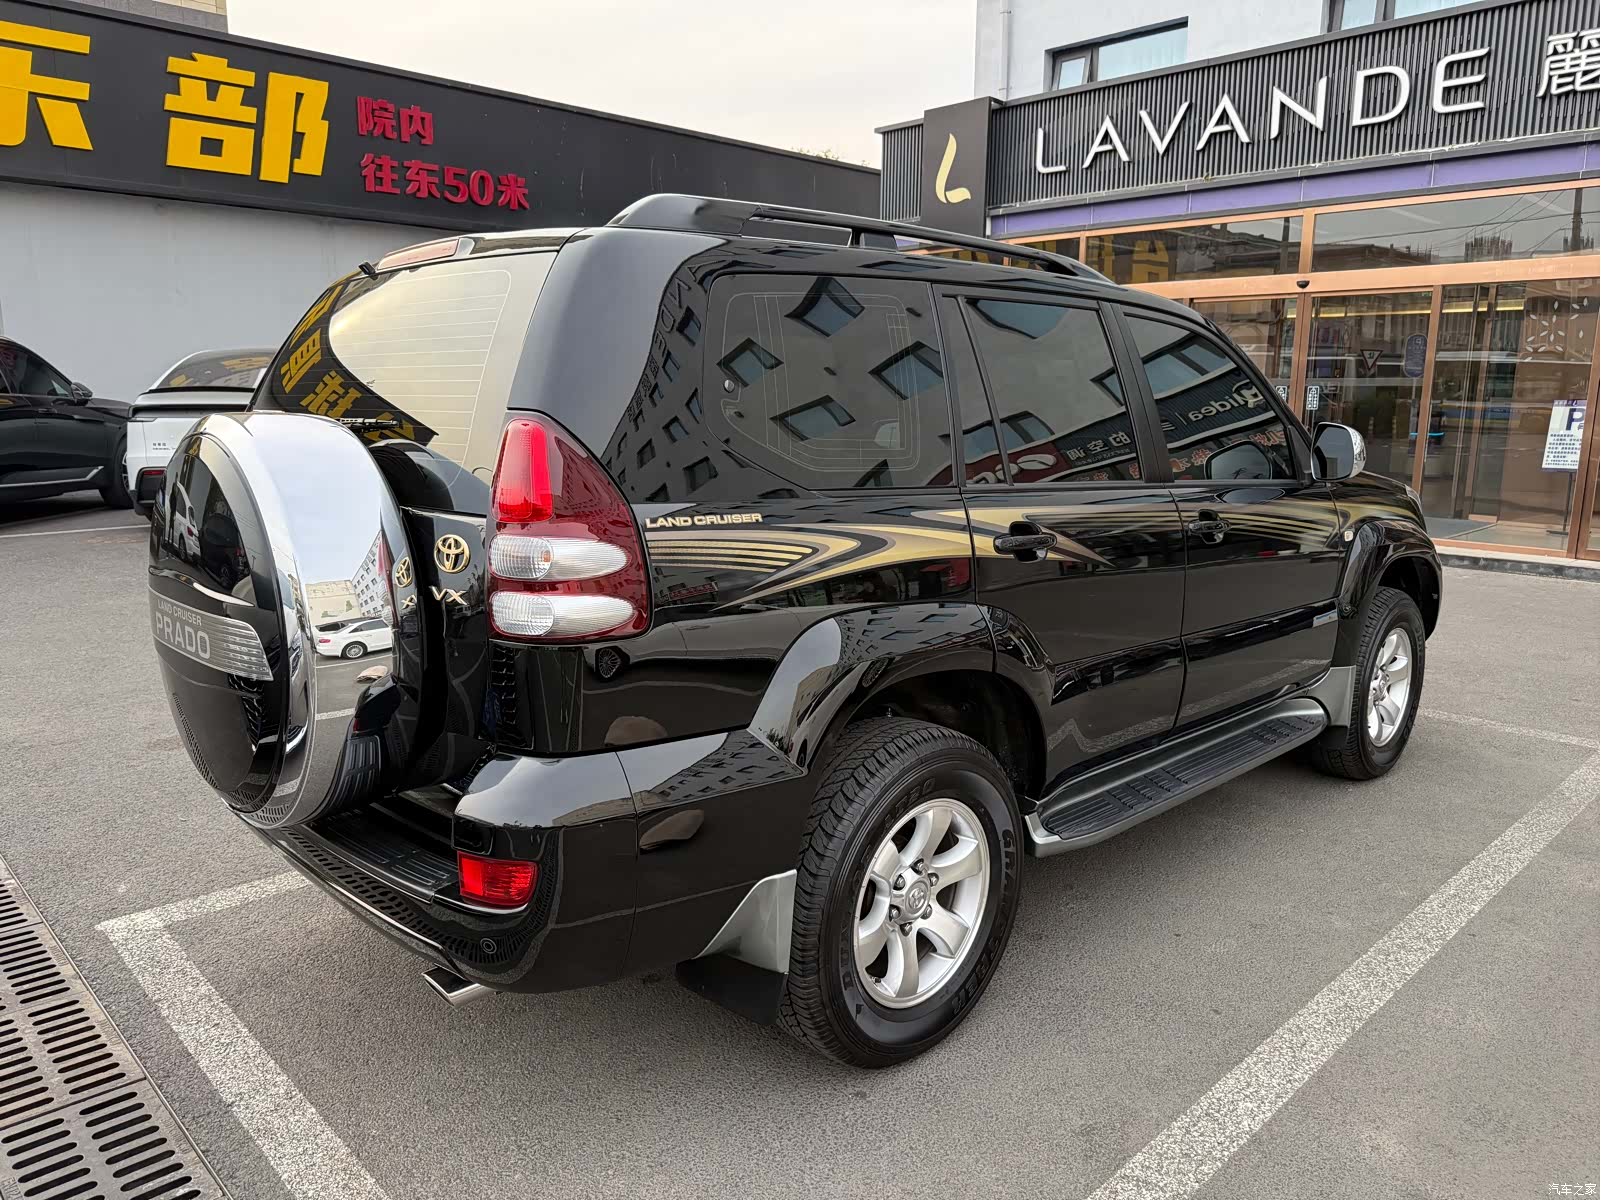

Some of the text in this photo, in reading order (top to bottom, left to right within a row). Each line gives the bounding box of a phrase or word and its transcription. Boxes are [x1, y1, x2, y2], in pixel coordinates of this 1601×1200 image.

[357, 96, 434, 145] 院内
[1035, 46, 1491, 174] LAVANDE
[360, 153, 530, 210] 往东50米
[645, 512, 763, 529] LAND CRUISER
[157, 600, 202, 627] LAND CRUISER
[428, 584, 470, 606] VX
[154, 611, 211, 660] PRADO
